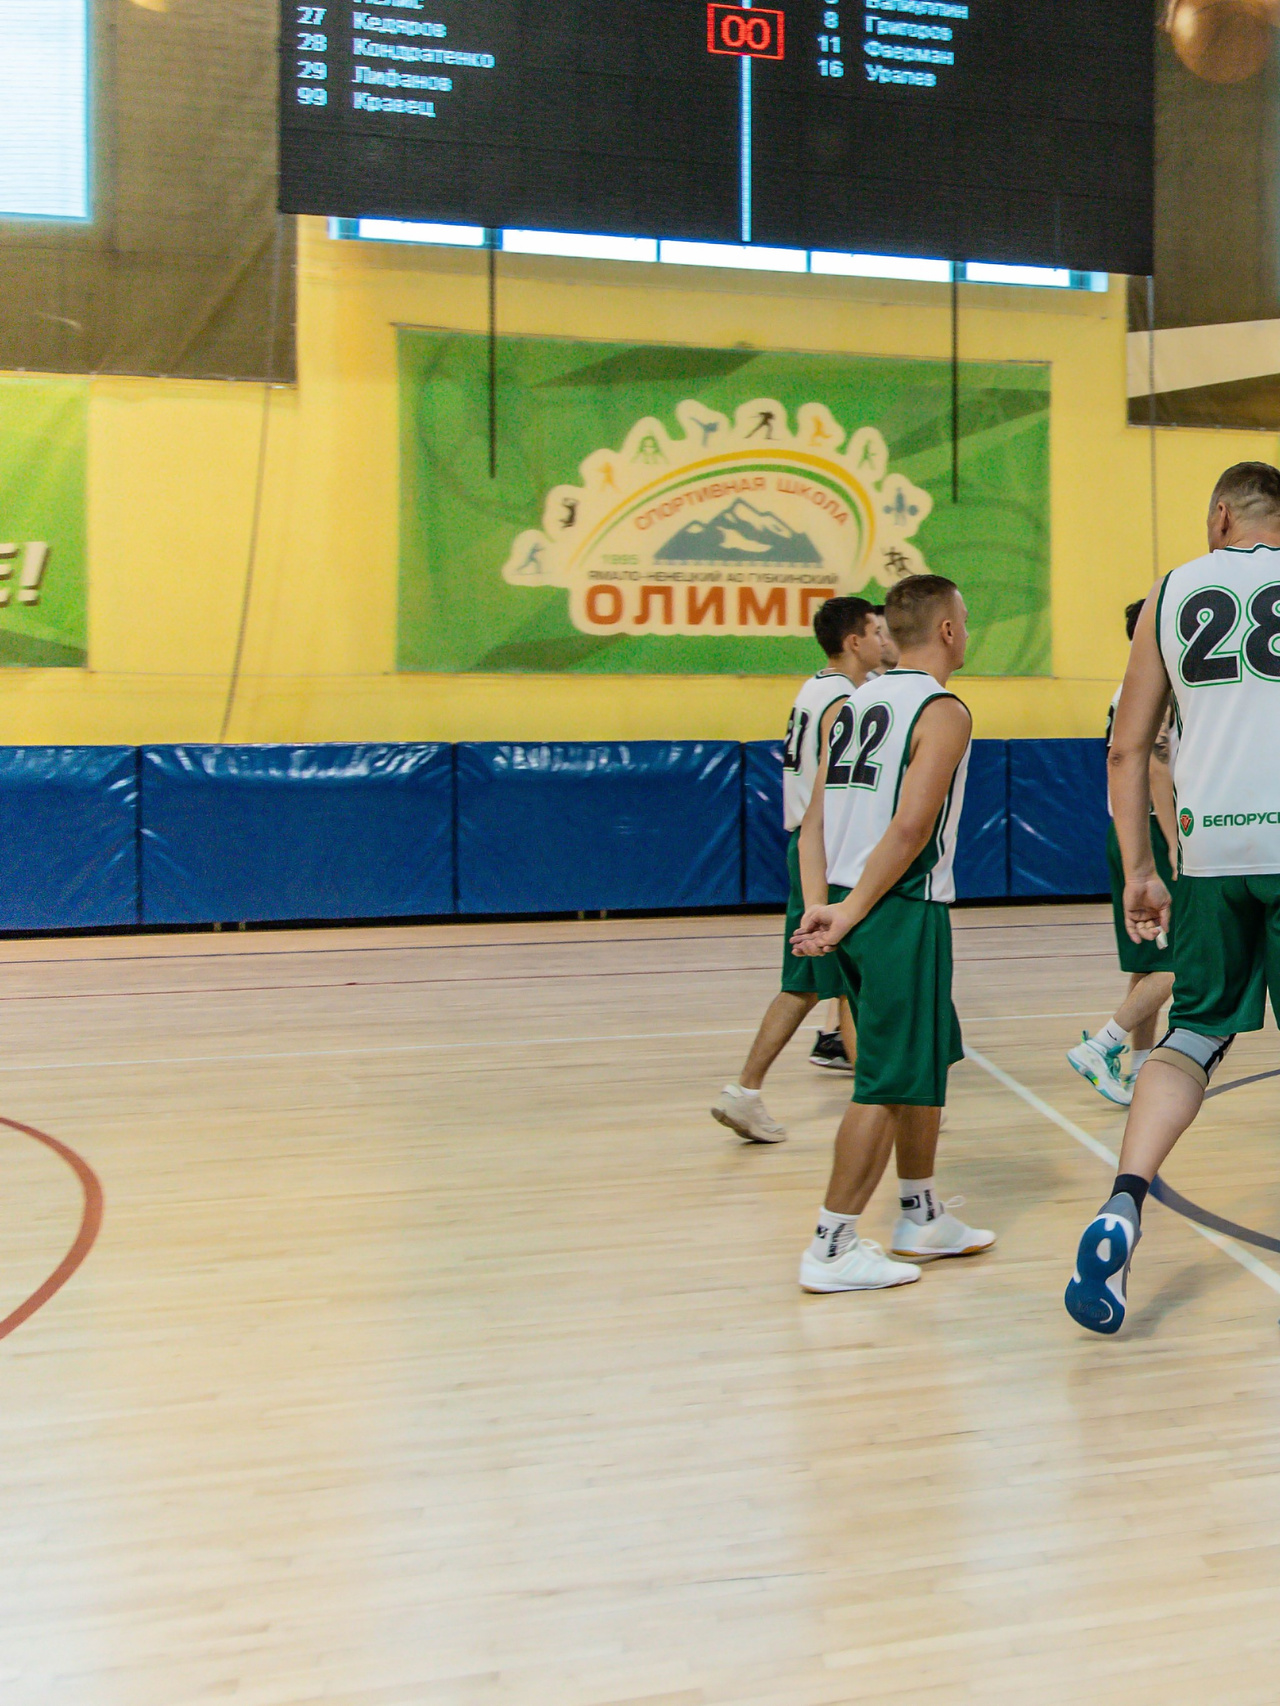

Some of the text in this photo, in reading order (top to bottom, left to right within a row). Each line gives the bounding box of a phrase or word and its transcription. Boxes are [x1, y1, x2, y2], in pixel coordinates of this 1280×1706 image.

[297, 6, 327, 25] 27
[823, 11, 839, 29] 8
[720, 15, 771, 50] 00
[817, 35, 841, 53] 11
[297, 33, 495, 68] 28 Кондратенко
[297, 60, 453, 92] 29 Лифанов
[817, 59, 844, 78] 16
[297, 87, 436, 118] 99 Кравец
[634, 477, 849, 531] СПОРТИВНАЯ ШКОЛА
[586, 584, 835, 627] ОЛИМП
[825, 701, 894, 791] 22
